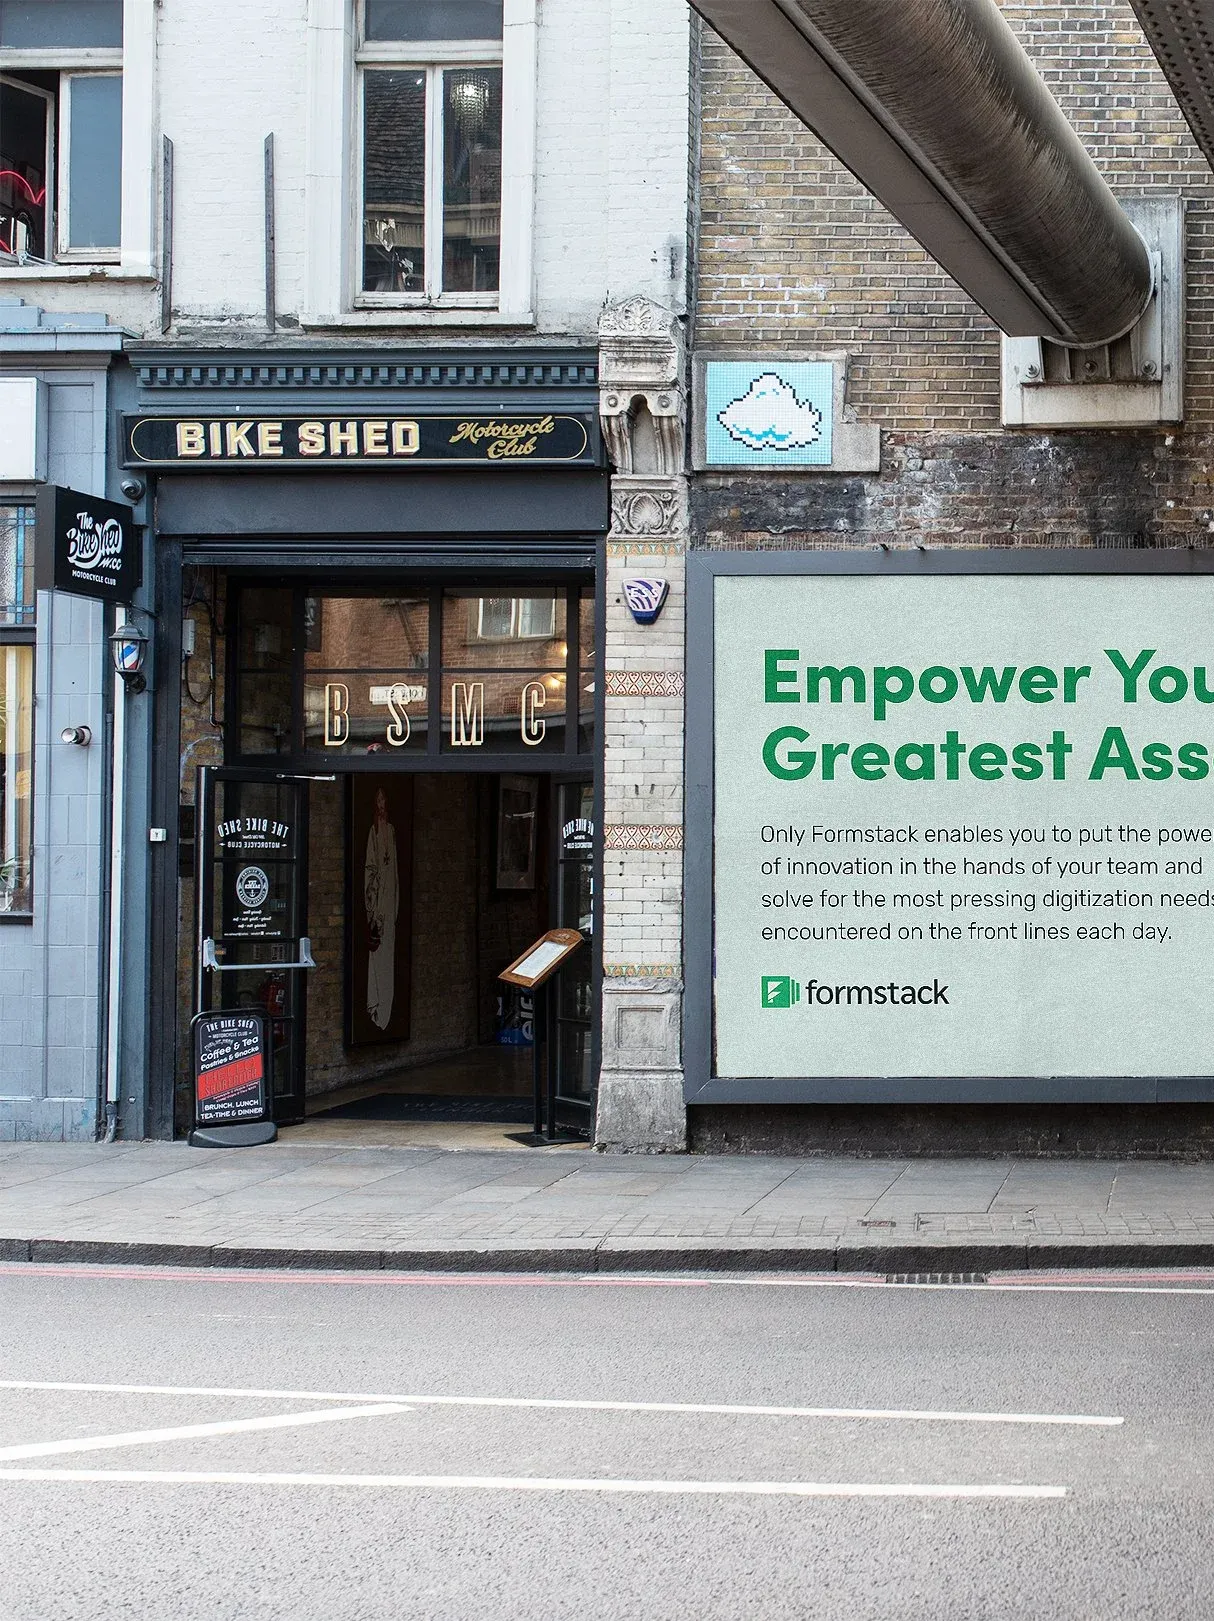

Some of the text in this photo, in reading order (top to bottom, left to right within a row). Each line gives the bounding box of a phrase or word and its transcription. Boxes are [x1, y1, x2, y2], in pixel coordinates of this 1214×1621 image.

[176, 420, 420, 457] BIKE SHED
[449, 415, 555, 444] Motorcycle
[487, 436, 538, 459] Club
[76, 511, 93, 530] The
[72, 569, 117, 586] MOTORCYCLE CLUB
[765, 650, 1091, 720] Empower
[763, 726, 1072, 781] Greatest
[761, 826, 805, 846] Only
[812, 826, 918, 843] Formstack
[925, 825, 1003, 843] enables
[1009, 829, 1045, 846] you
[1051, 826, 1072, 843] to
[1079, 826, 1112, 846] put
[1118, 825, 1151, 843] the
[761, 857, 1203, 878] of innovation in the hands of your team and
[761, 890, 814, 907] solve
[820, 889, 848, 907] for
[853, 890, 885, 907] the
[893, 891, 944, 907] most
[950, 890, 1036, 911] pressing
[1043, 889, 1152, 911] digitization
[762, 922, 1171, 943] encountered on the front lines each day.
[805, 979, 950, 1005] formstack
[206, 1019, 254, 1032] THE BIKE SHED
[200, 1036, 259, 1062] Coffee & Tea
[200, 1058, 228, 1071] Pastries
[234, 1045, 260, 1058] Snacks
[201, 1111, 230, 1119] TEA-TIME
[238, 1107, 263, 1116] DINNER
[204, 1100, 259, 1111] BRUNCH, LUNCH
